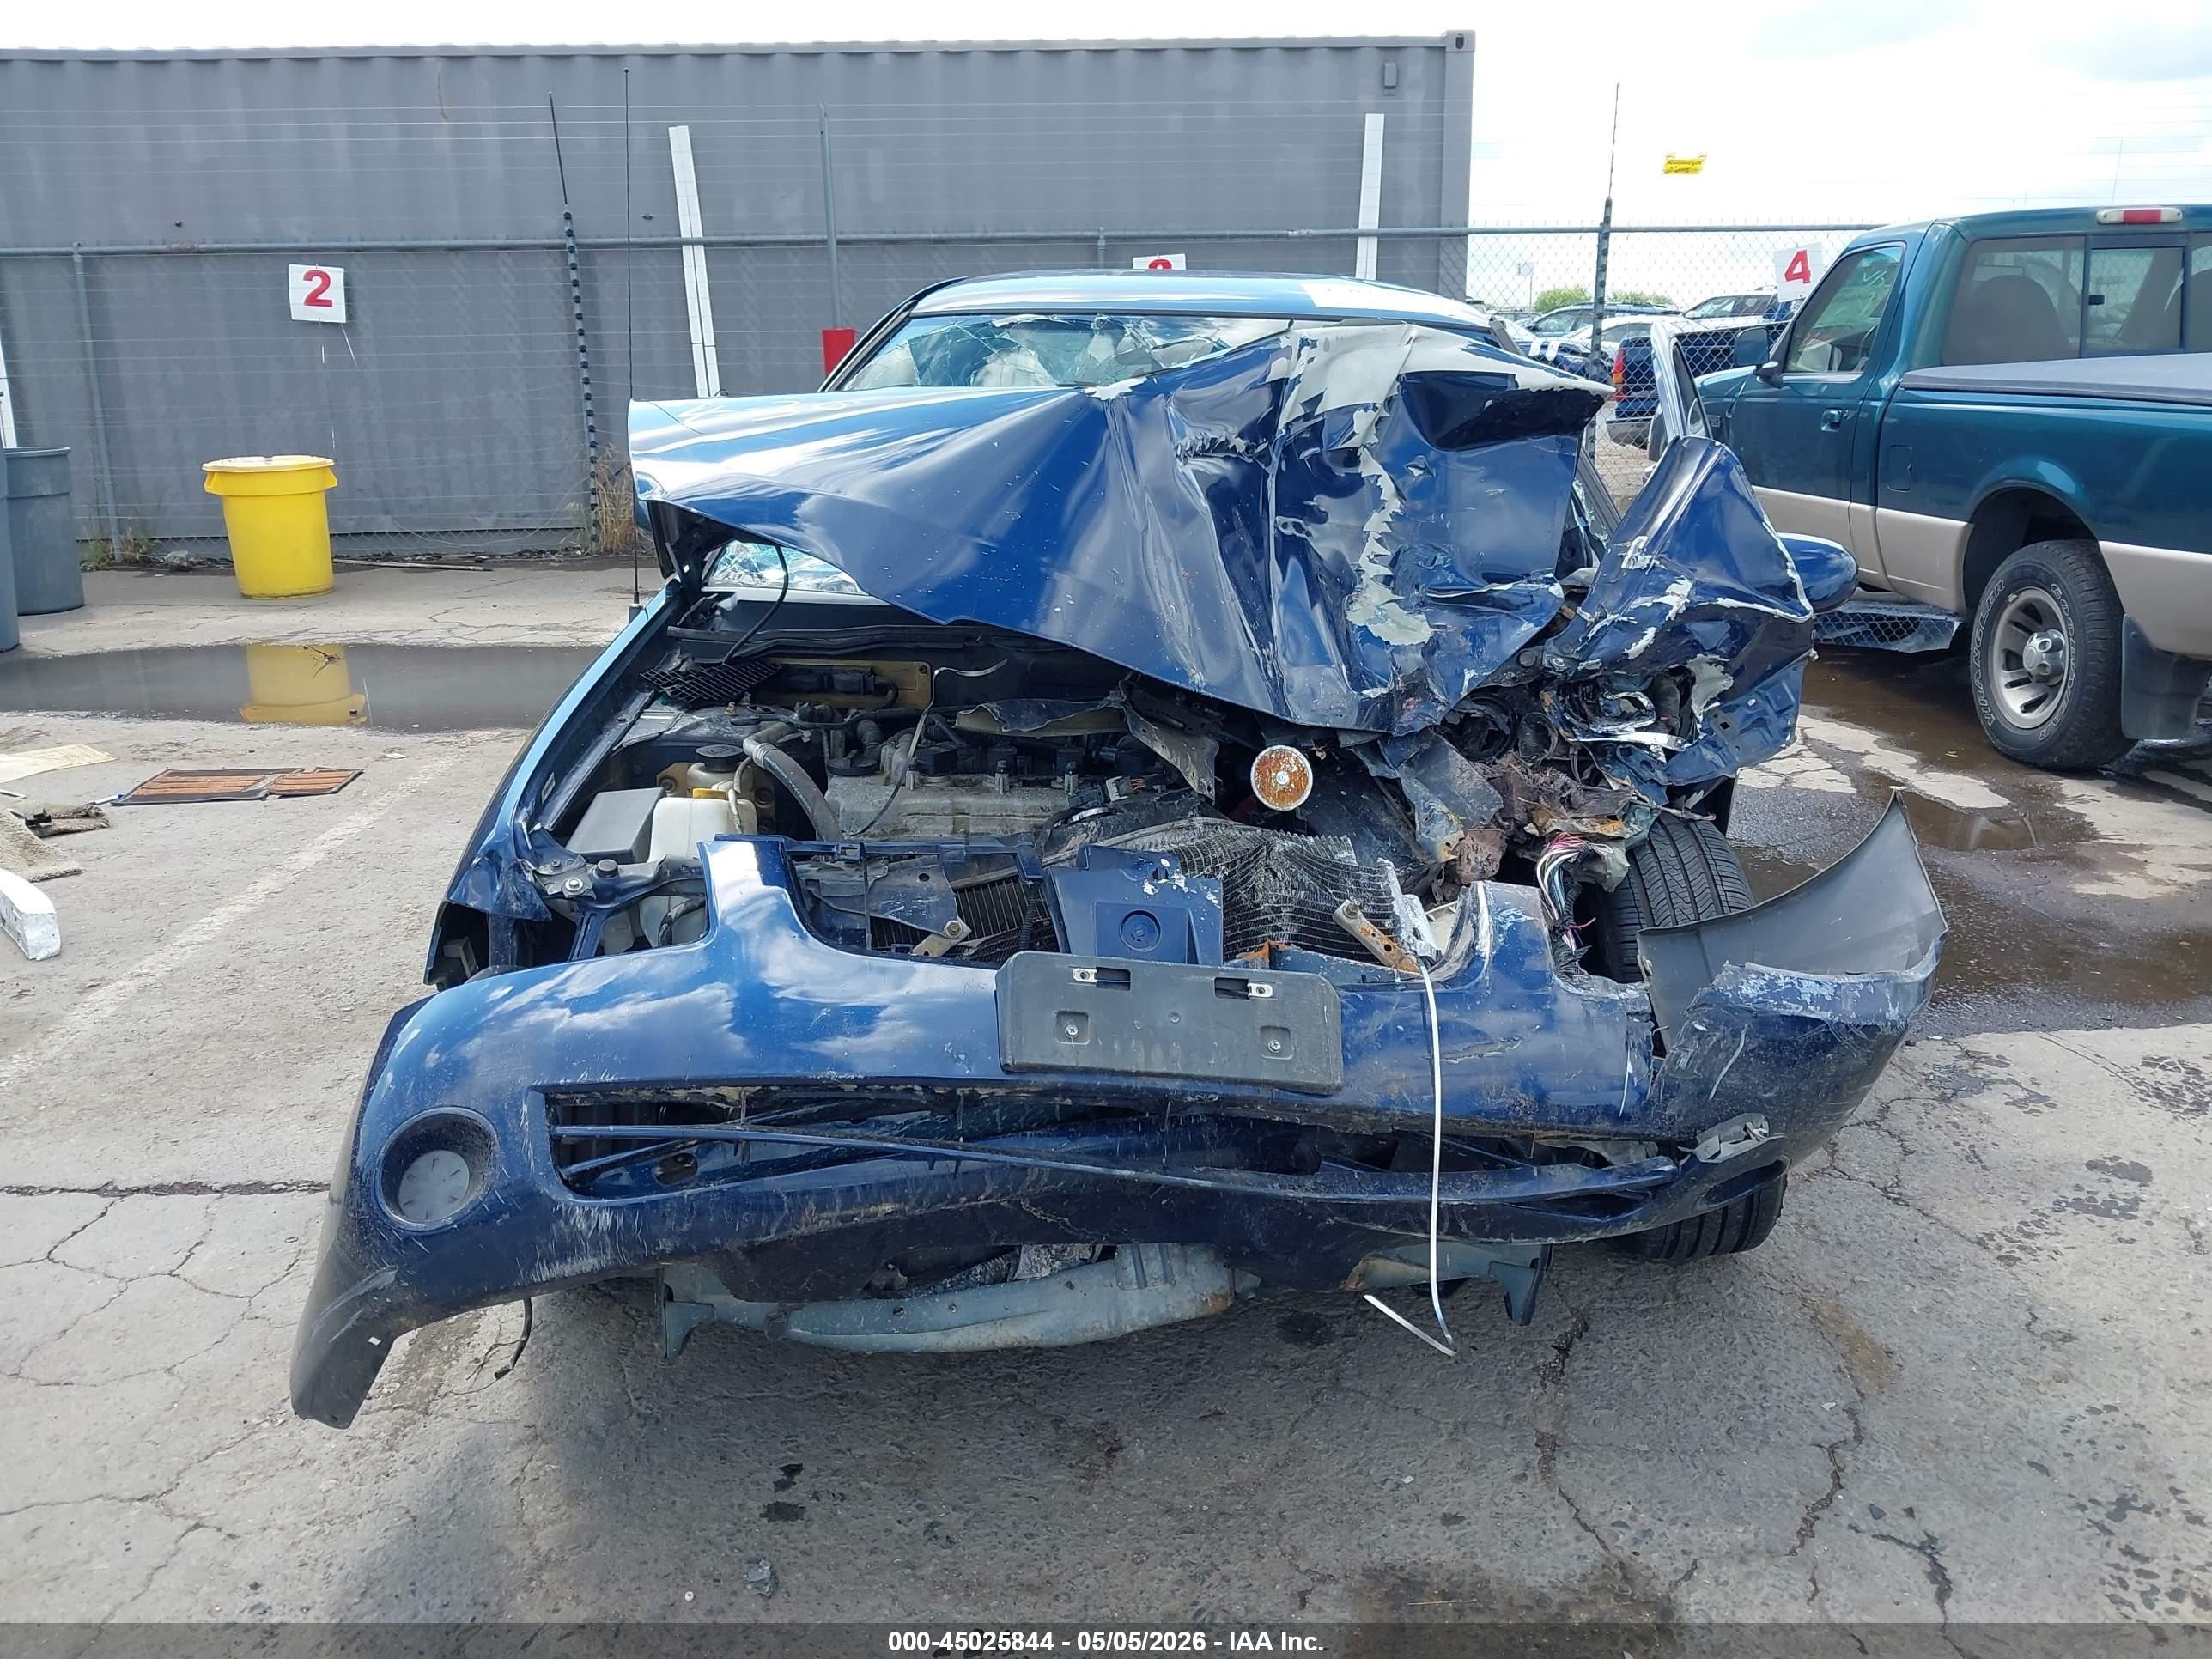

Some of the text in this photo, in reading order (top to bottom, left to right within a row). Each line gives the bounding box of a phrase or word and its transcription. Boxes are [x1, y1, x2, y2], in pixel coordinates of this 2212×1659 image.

[302, 270, 333, 307] 2
[1784, 249, 1811, 284] 4
[1973, 580, 2005, 726] WRANGLER
[2039, 583, 2076, 741] GOODYEAR
